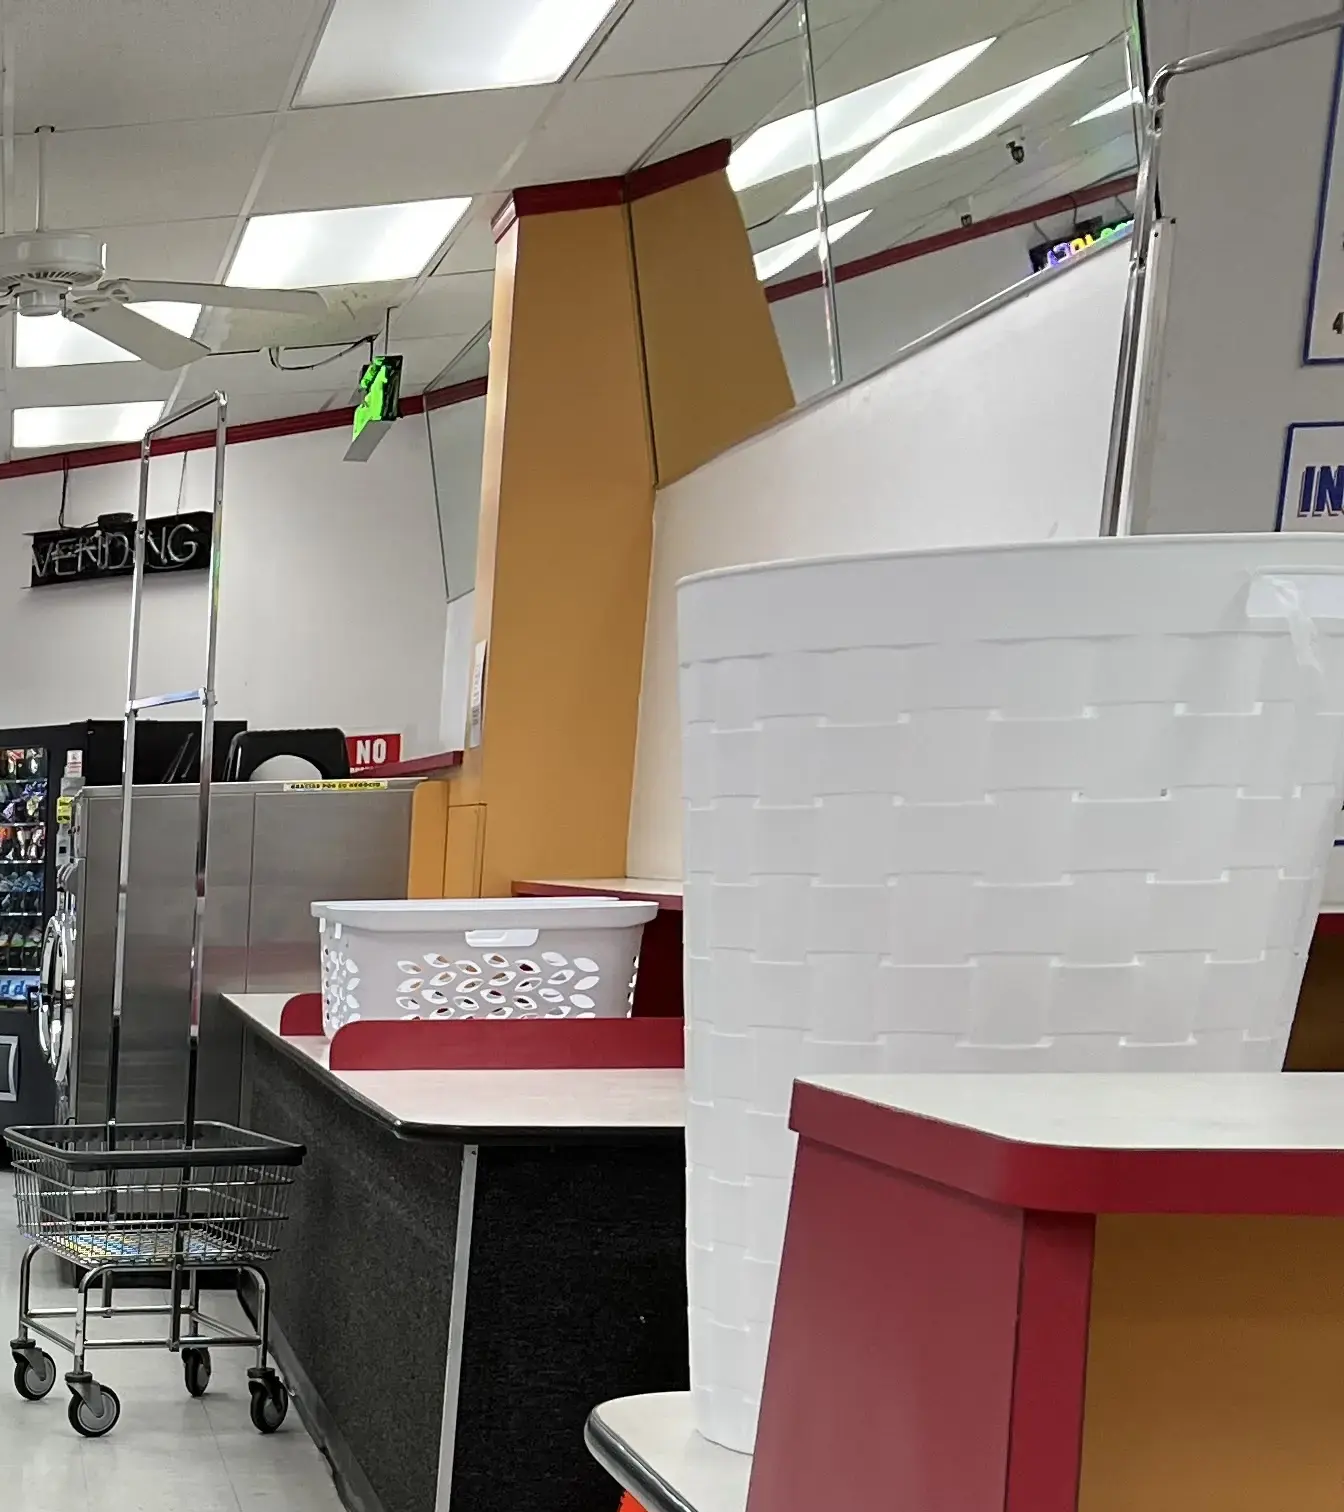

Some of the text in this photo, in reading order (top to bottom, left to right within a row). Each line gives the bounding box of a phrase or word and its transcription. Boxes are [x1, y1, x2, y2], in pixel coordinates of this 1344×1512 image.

[1297, 464, 1344, 518] IN
[32, 523, 199, 579] VENDNG
[355, 738, 387, 765] NO
